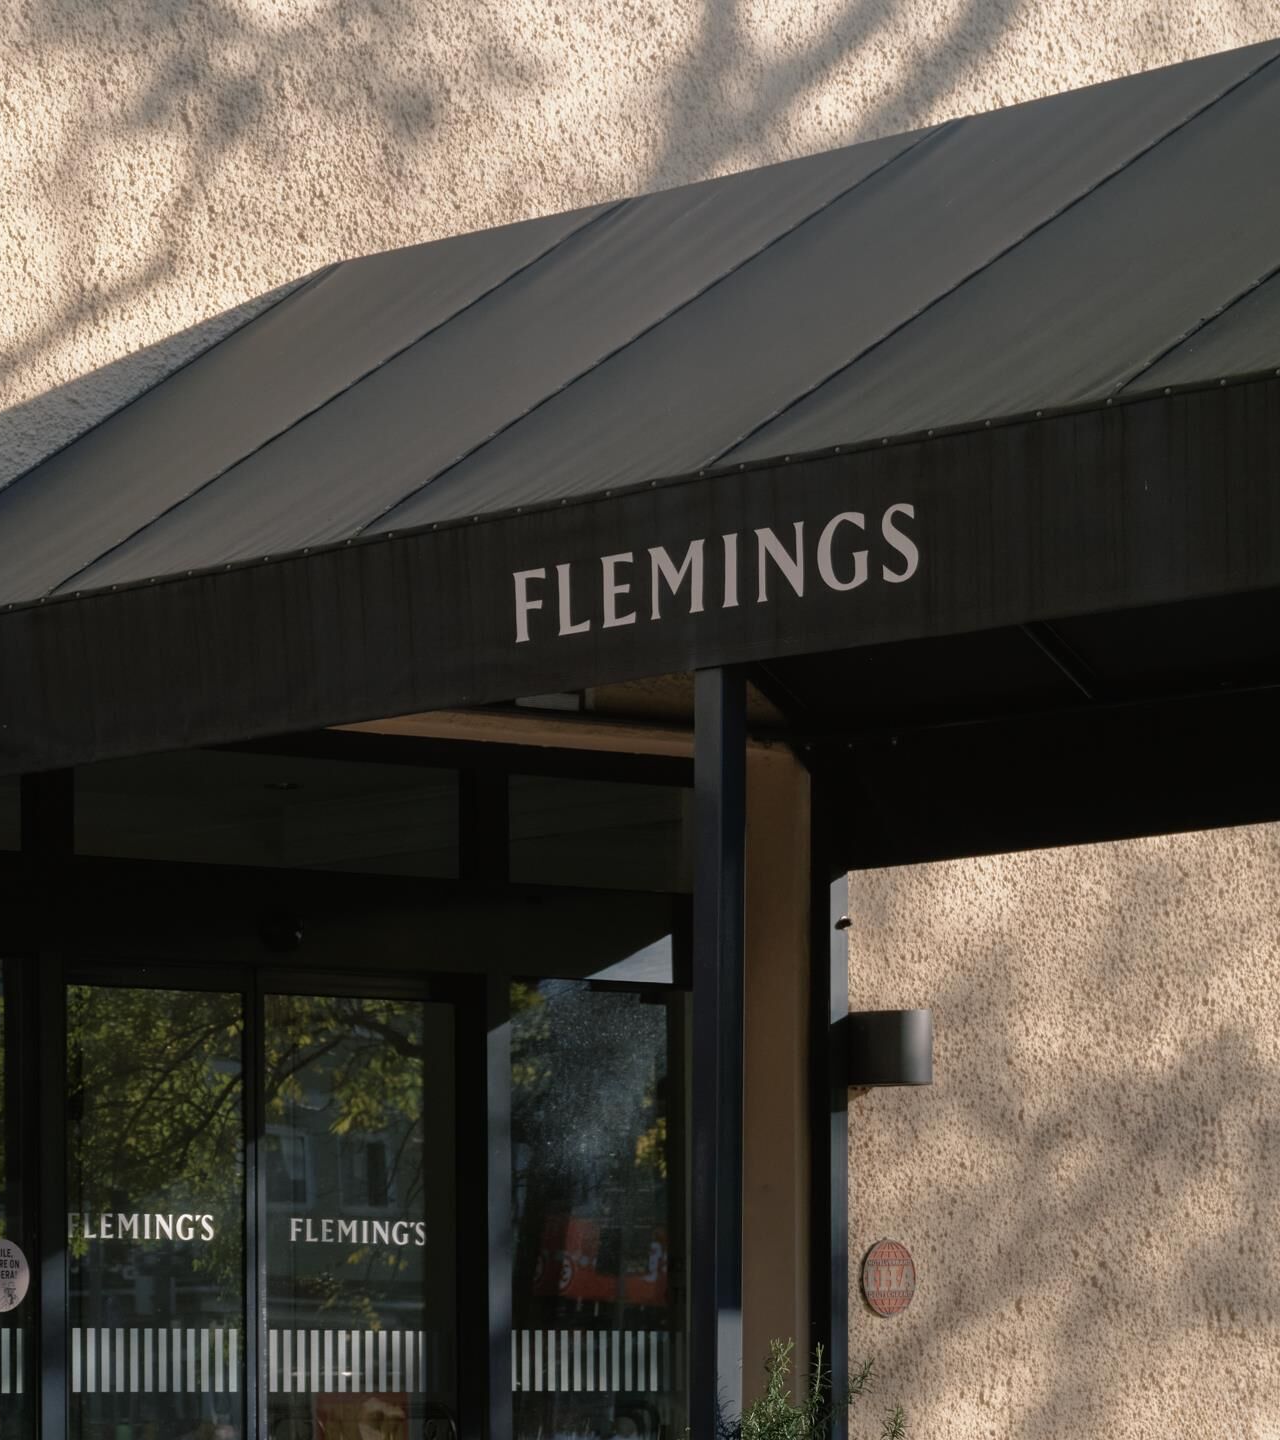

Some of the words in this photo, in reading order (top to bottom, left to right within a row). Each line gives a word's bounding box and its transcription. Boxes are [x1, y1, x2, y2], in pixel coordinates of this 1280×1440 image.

[512, 503, 920, 643] FLEMINGS
[67, 1212, 215, 1241] FLEMING'S
[289, 1217, 426, 1247] FLEMING'S
[9, 1260, 20, 1269] ON
